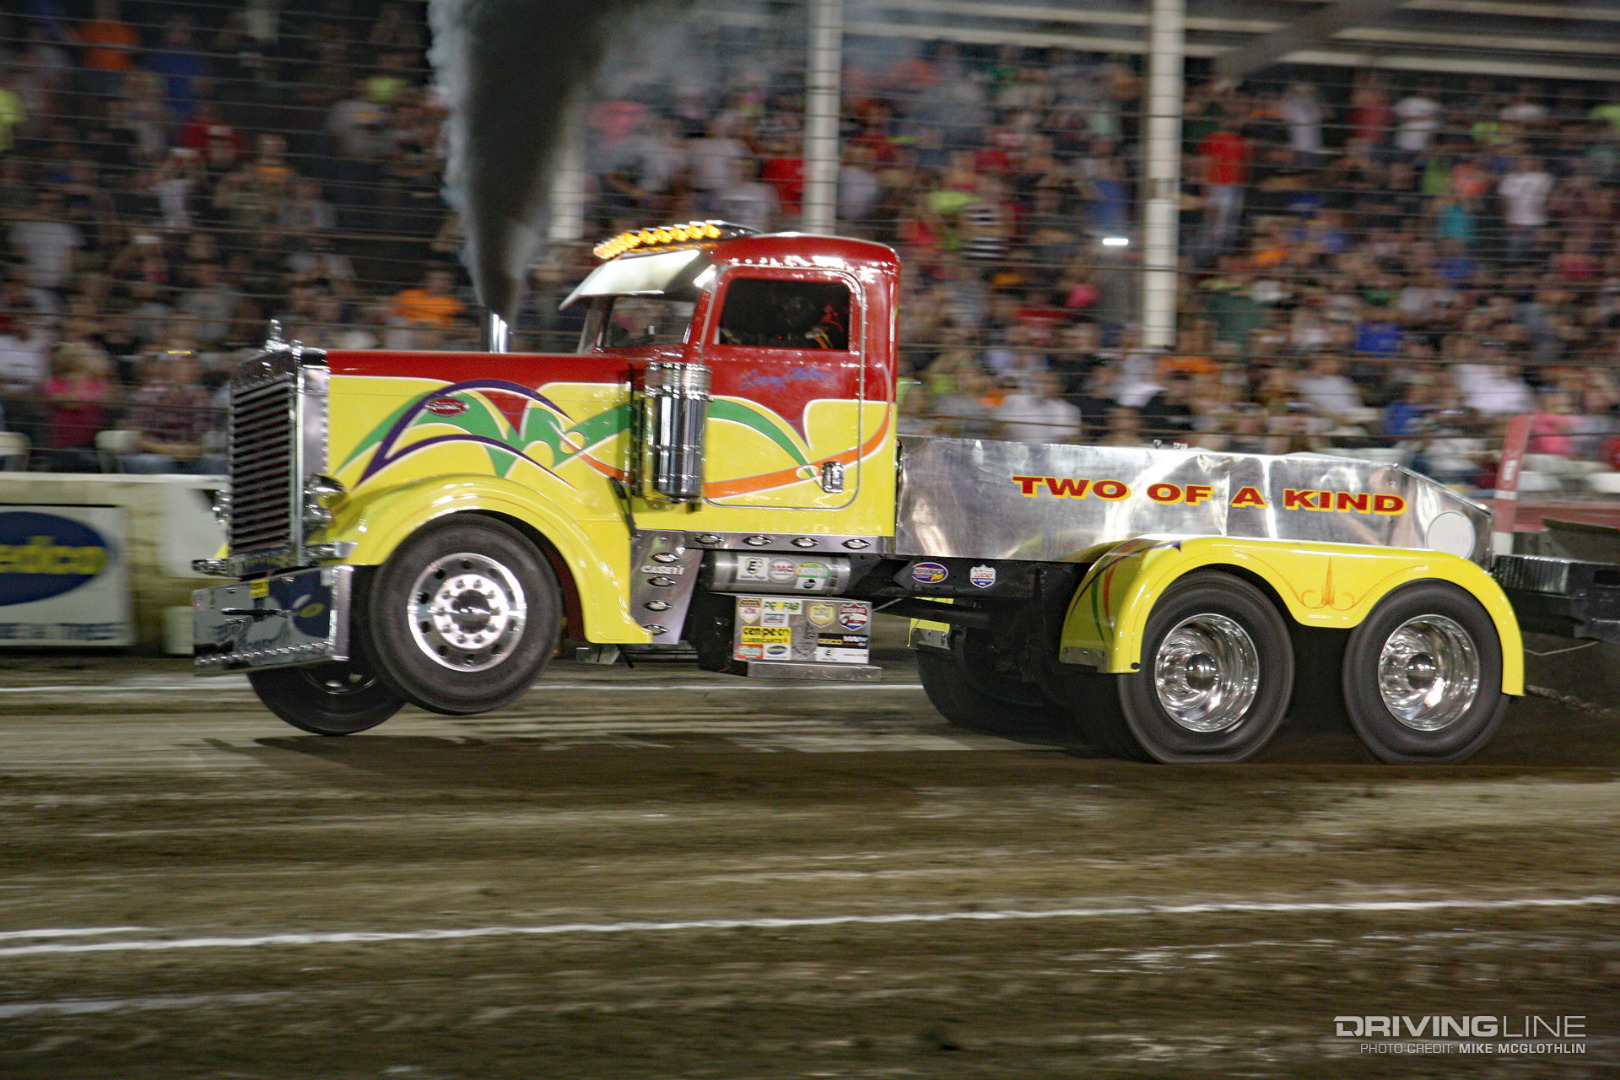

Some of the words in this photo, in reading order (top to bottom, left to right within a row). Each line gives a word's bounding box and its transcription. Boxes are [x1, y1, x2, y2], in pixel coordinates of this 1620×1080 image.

[1012, 475, 1131, 501] TWO
[1146, 483, 1215, 505] OF
[1230, 486, 1268, 508] A
[1282, 488, 1408, 515] KIND
